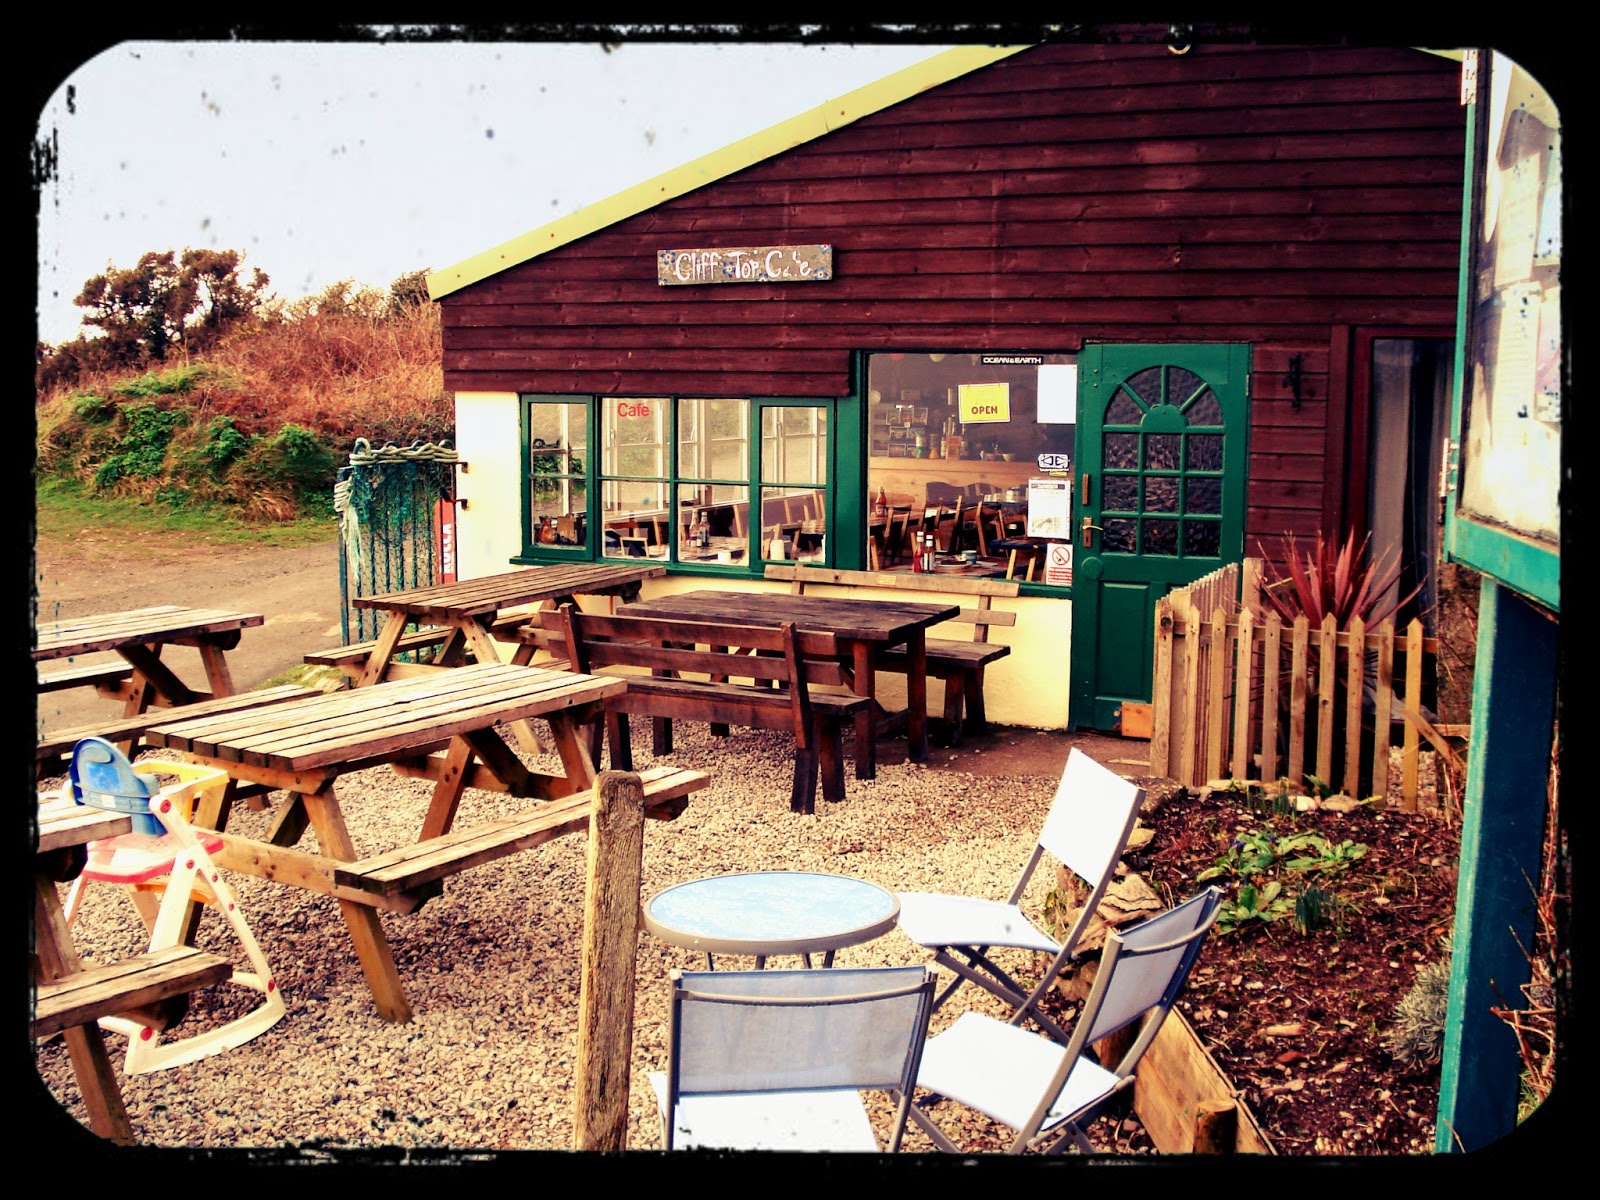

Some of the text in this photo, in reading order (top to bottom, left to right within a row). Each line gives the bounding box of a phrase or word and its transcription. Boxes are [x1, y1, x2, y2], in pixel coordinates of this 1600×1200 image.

[675, 252, 719, 281] Cliff
[726, 251, 759, 279] Top
[617, 402, 650, 418] Cafe
[971, 405, 998, 415] OPEN
